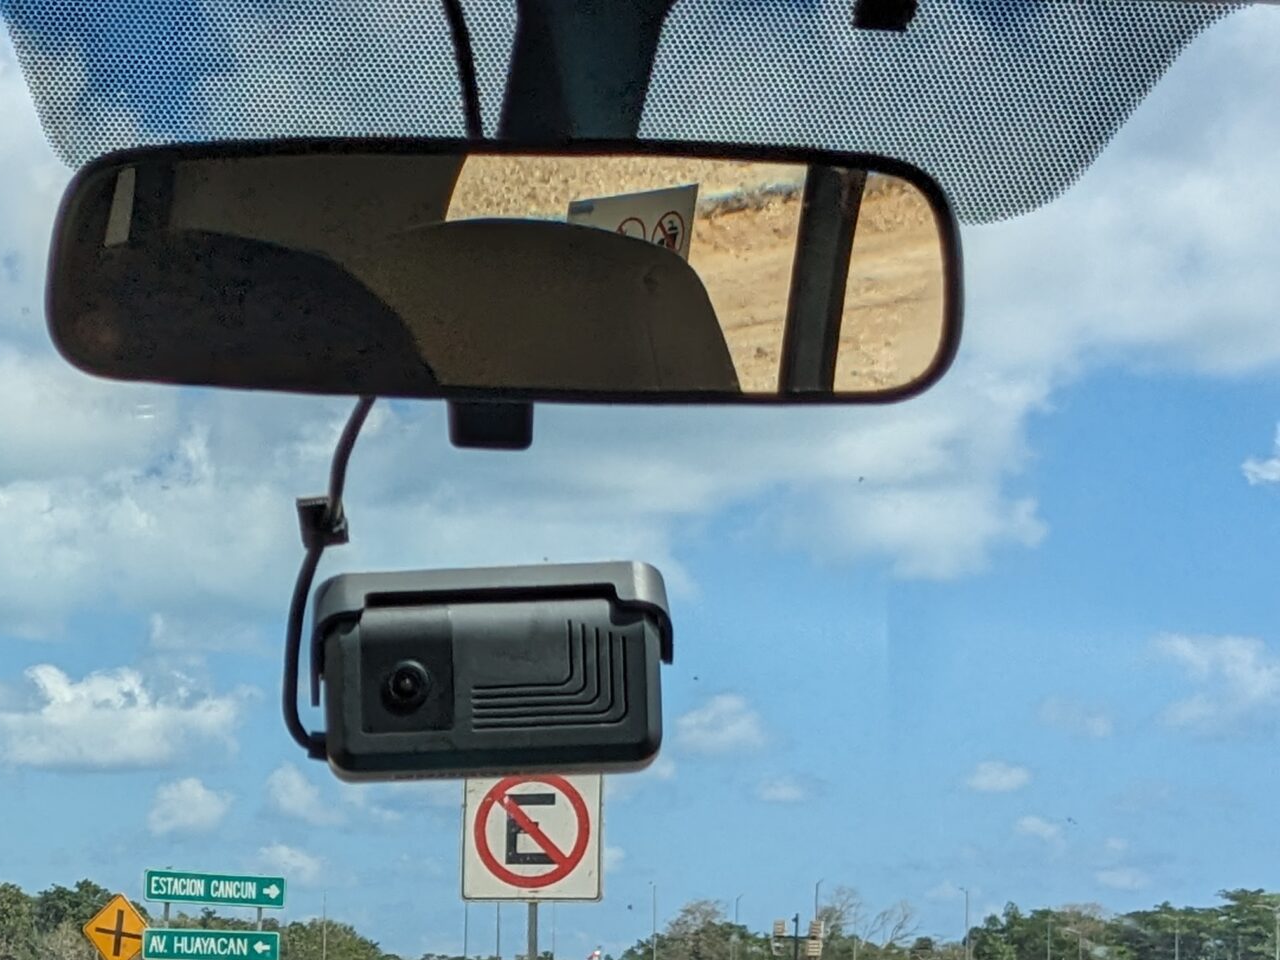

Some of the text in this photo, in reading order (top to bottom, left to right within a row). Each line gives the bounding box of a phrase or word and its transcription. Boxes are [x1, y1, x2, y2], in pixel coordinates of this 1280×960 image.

[150, 876, 257, 899] ESTACION CANCUN
[149, 935, 248, 956] AV. HUAYACAN
